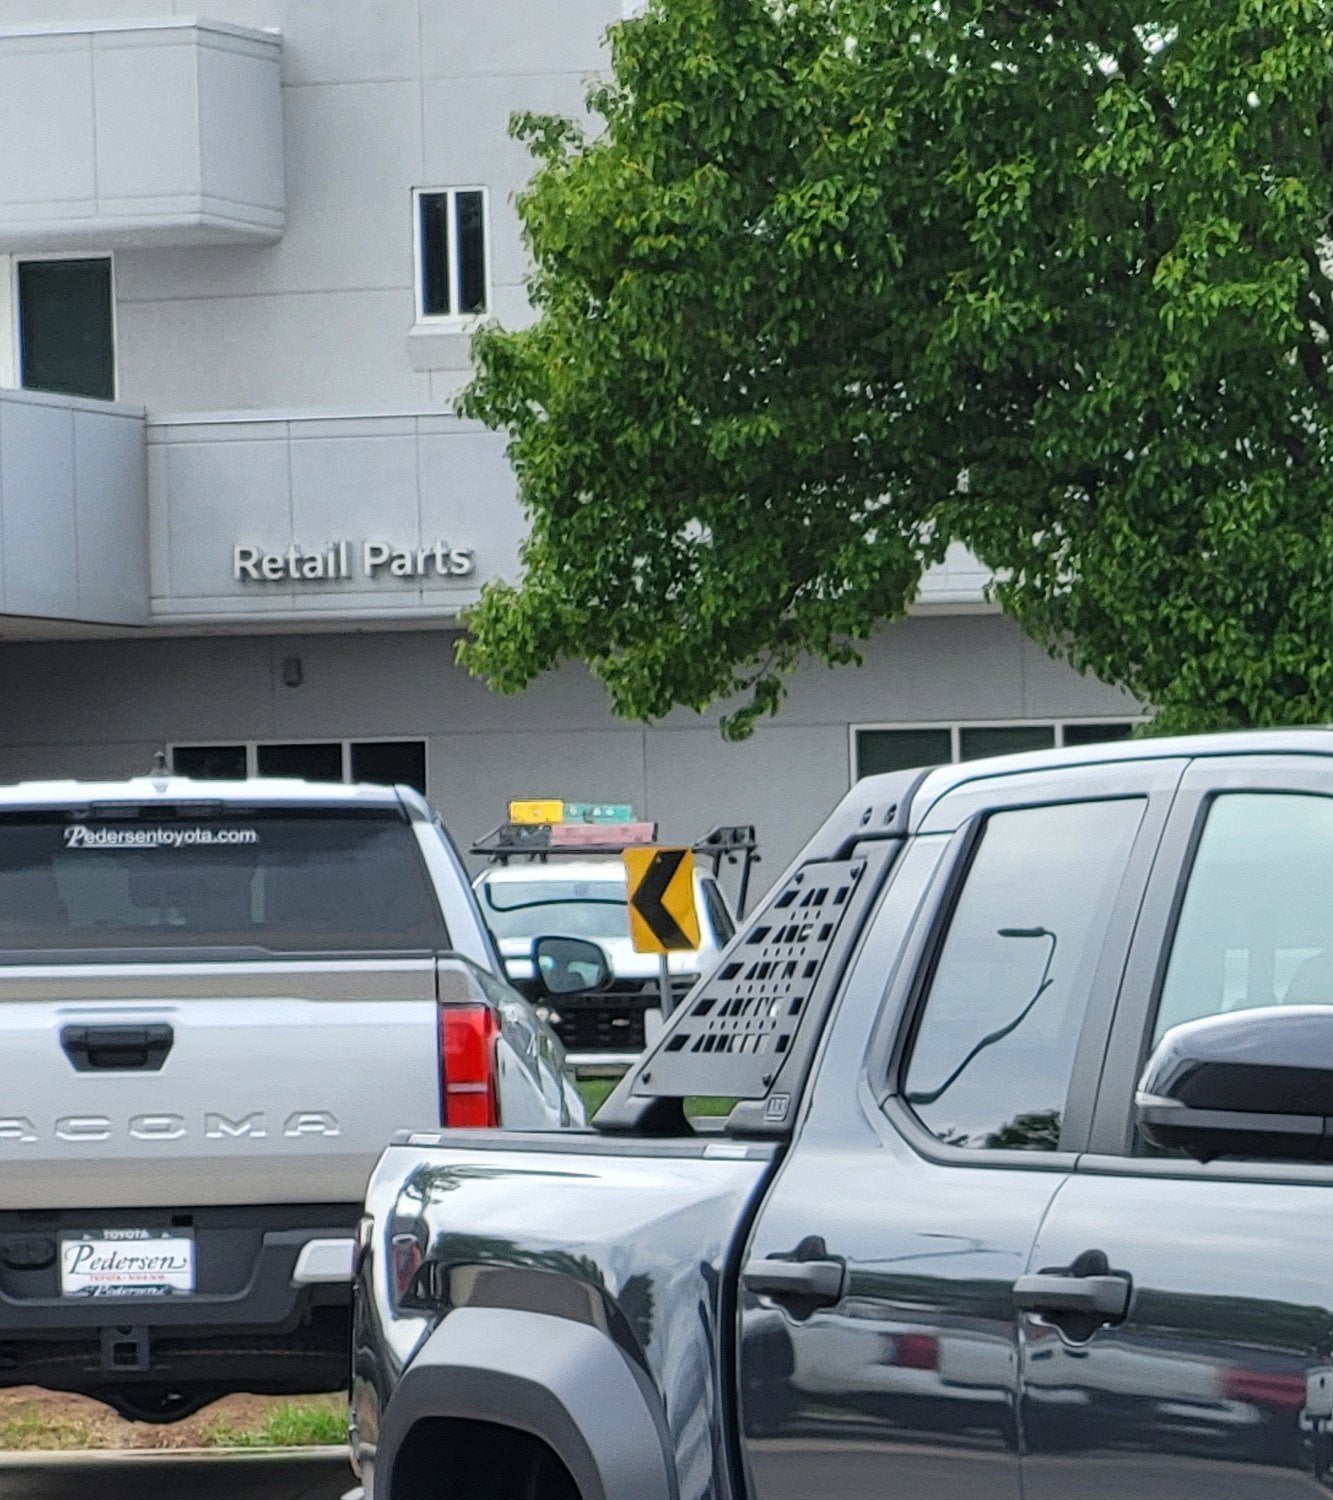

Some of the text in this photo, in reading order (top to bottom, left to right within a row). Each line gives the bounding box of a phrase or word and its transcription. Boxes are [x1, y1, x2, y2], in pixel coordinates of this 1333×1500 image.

[234, 540, 474, 580] Retail Parts
[64, 825, 258, 848] Pedersentoyota.com
[103, 1229, 149, 1240] TOYOTA
[66, 1244, 188, 1275] Pedersen
